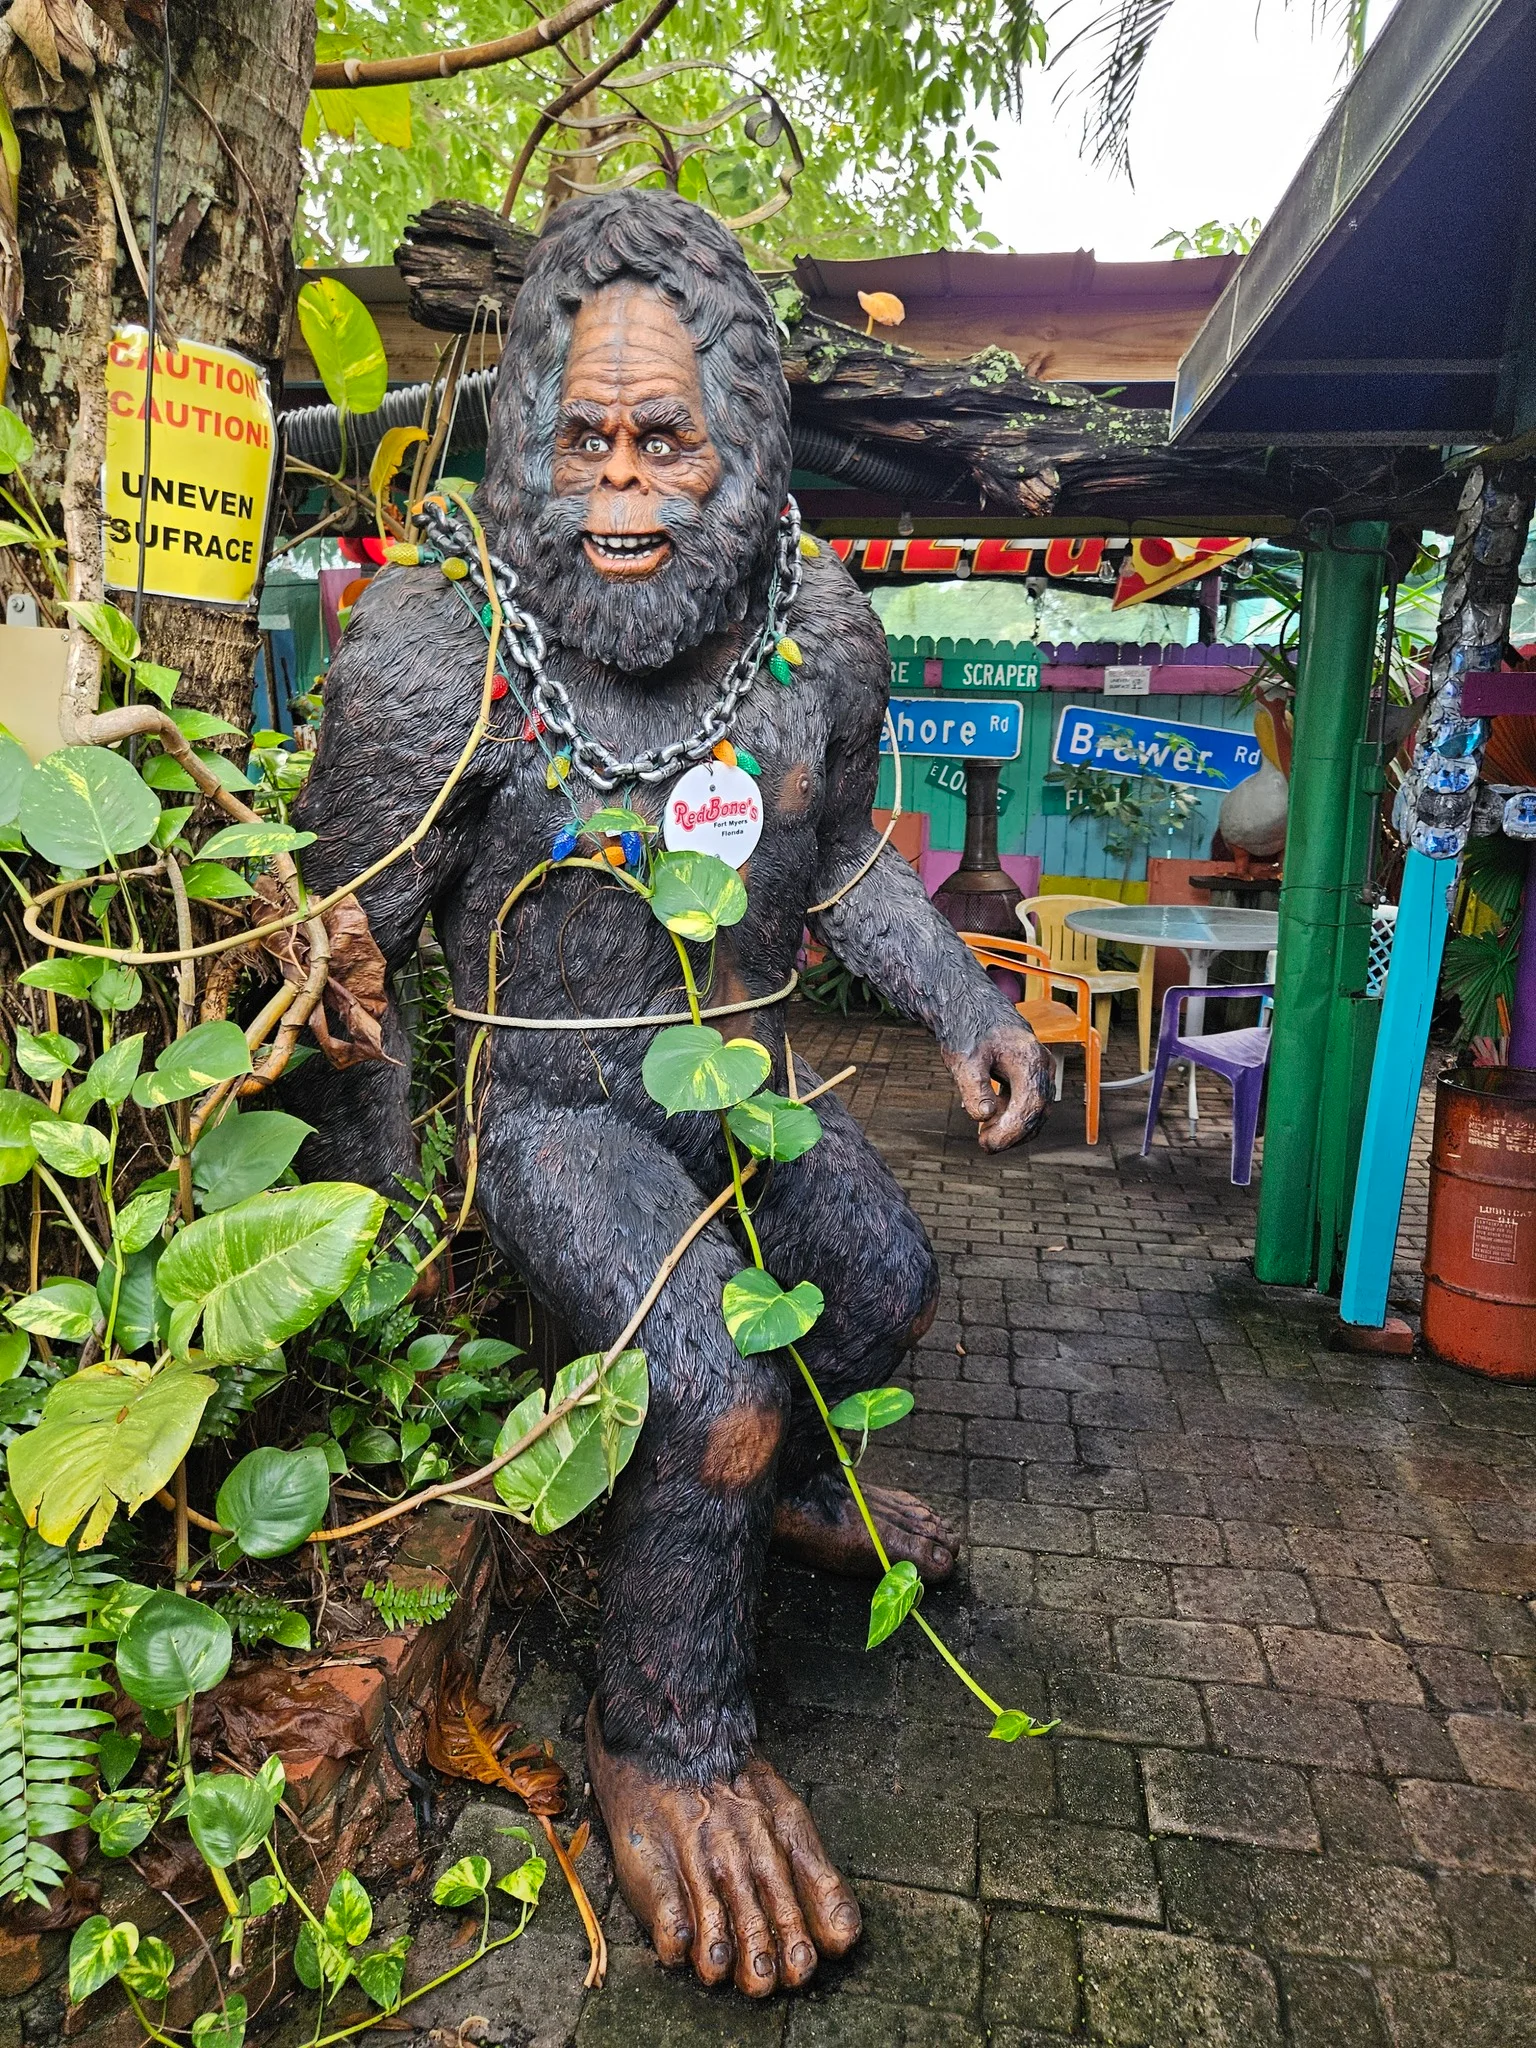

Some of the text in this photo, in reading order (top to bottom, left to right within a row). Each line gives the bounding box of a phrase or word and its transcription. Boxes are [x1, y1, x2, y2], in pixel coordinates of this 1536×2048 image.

[110, 390, 268, 449] CAUTION!
[122, 471, 253, 519] UNEVEN
[110, 518, 253, 564] SUFRACE
[962, 663, 1038, 687] SCRAPER
[989, 715, 1010, 733] Rd
[1234, 745, 1261, 765] Rd
[674, 797, 758, 832] RedBone's
[729, 819, 748, 827] Myers
[721, 829, 744, 837] Florida
